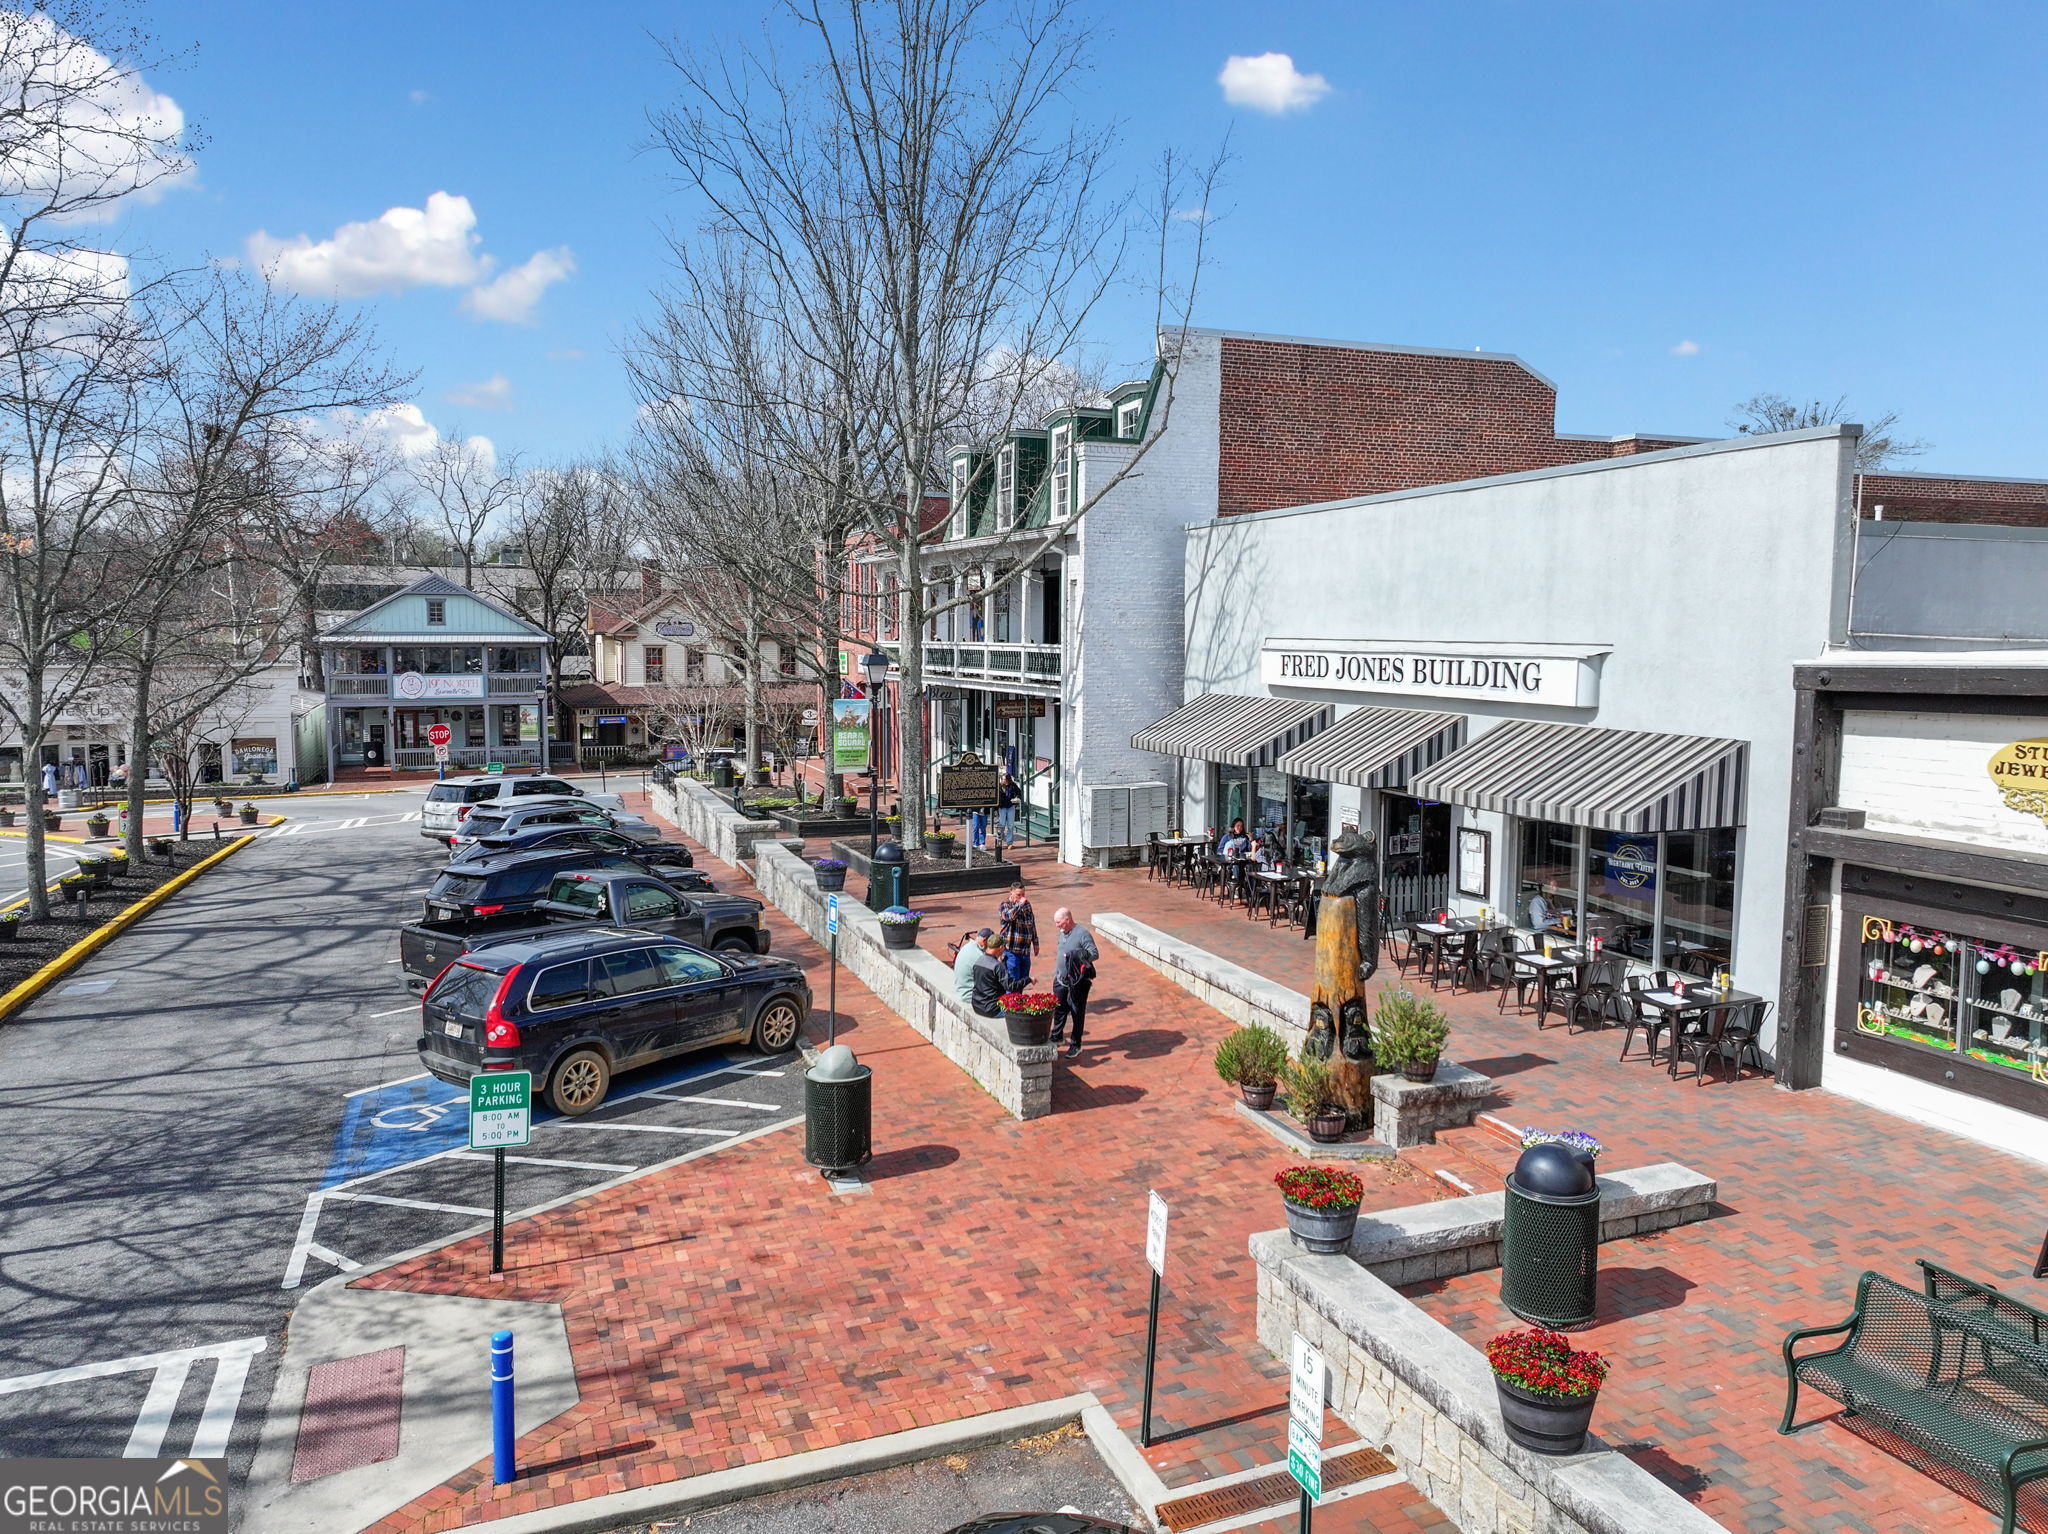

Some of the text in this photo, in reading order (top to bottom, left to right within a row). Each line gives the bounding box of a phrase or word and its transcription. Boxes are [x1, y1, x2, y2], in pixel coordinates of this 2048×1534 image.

[1280, 654, 1543, 691] FRED JONES BUILDING
[429, 730, 450, 740] STOP
[234, 746, 274, 755] DAHLONEGA
[480, 1082, 521, 1095] 3 HOUR
[478, 1094, 523, 1107] PARKING
[482, 1112, 520, 1122] 8:00 AM
[482, 1130, 519, 1141] 5:00 PM
[1303, 1352, 1313, 1374] 15
[1295, 1373, 1319, 1405] MINUTE
[1293, 1393, 1320, 1429] PARKING
[1290, 1455, 1319, 1495] $30 FINE
